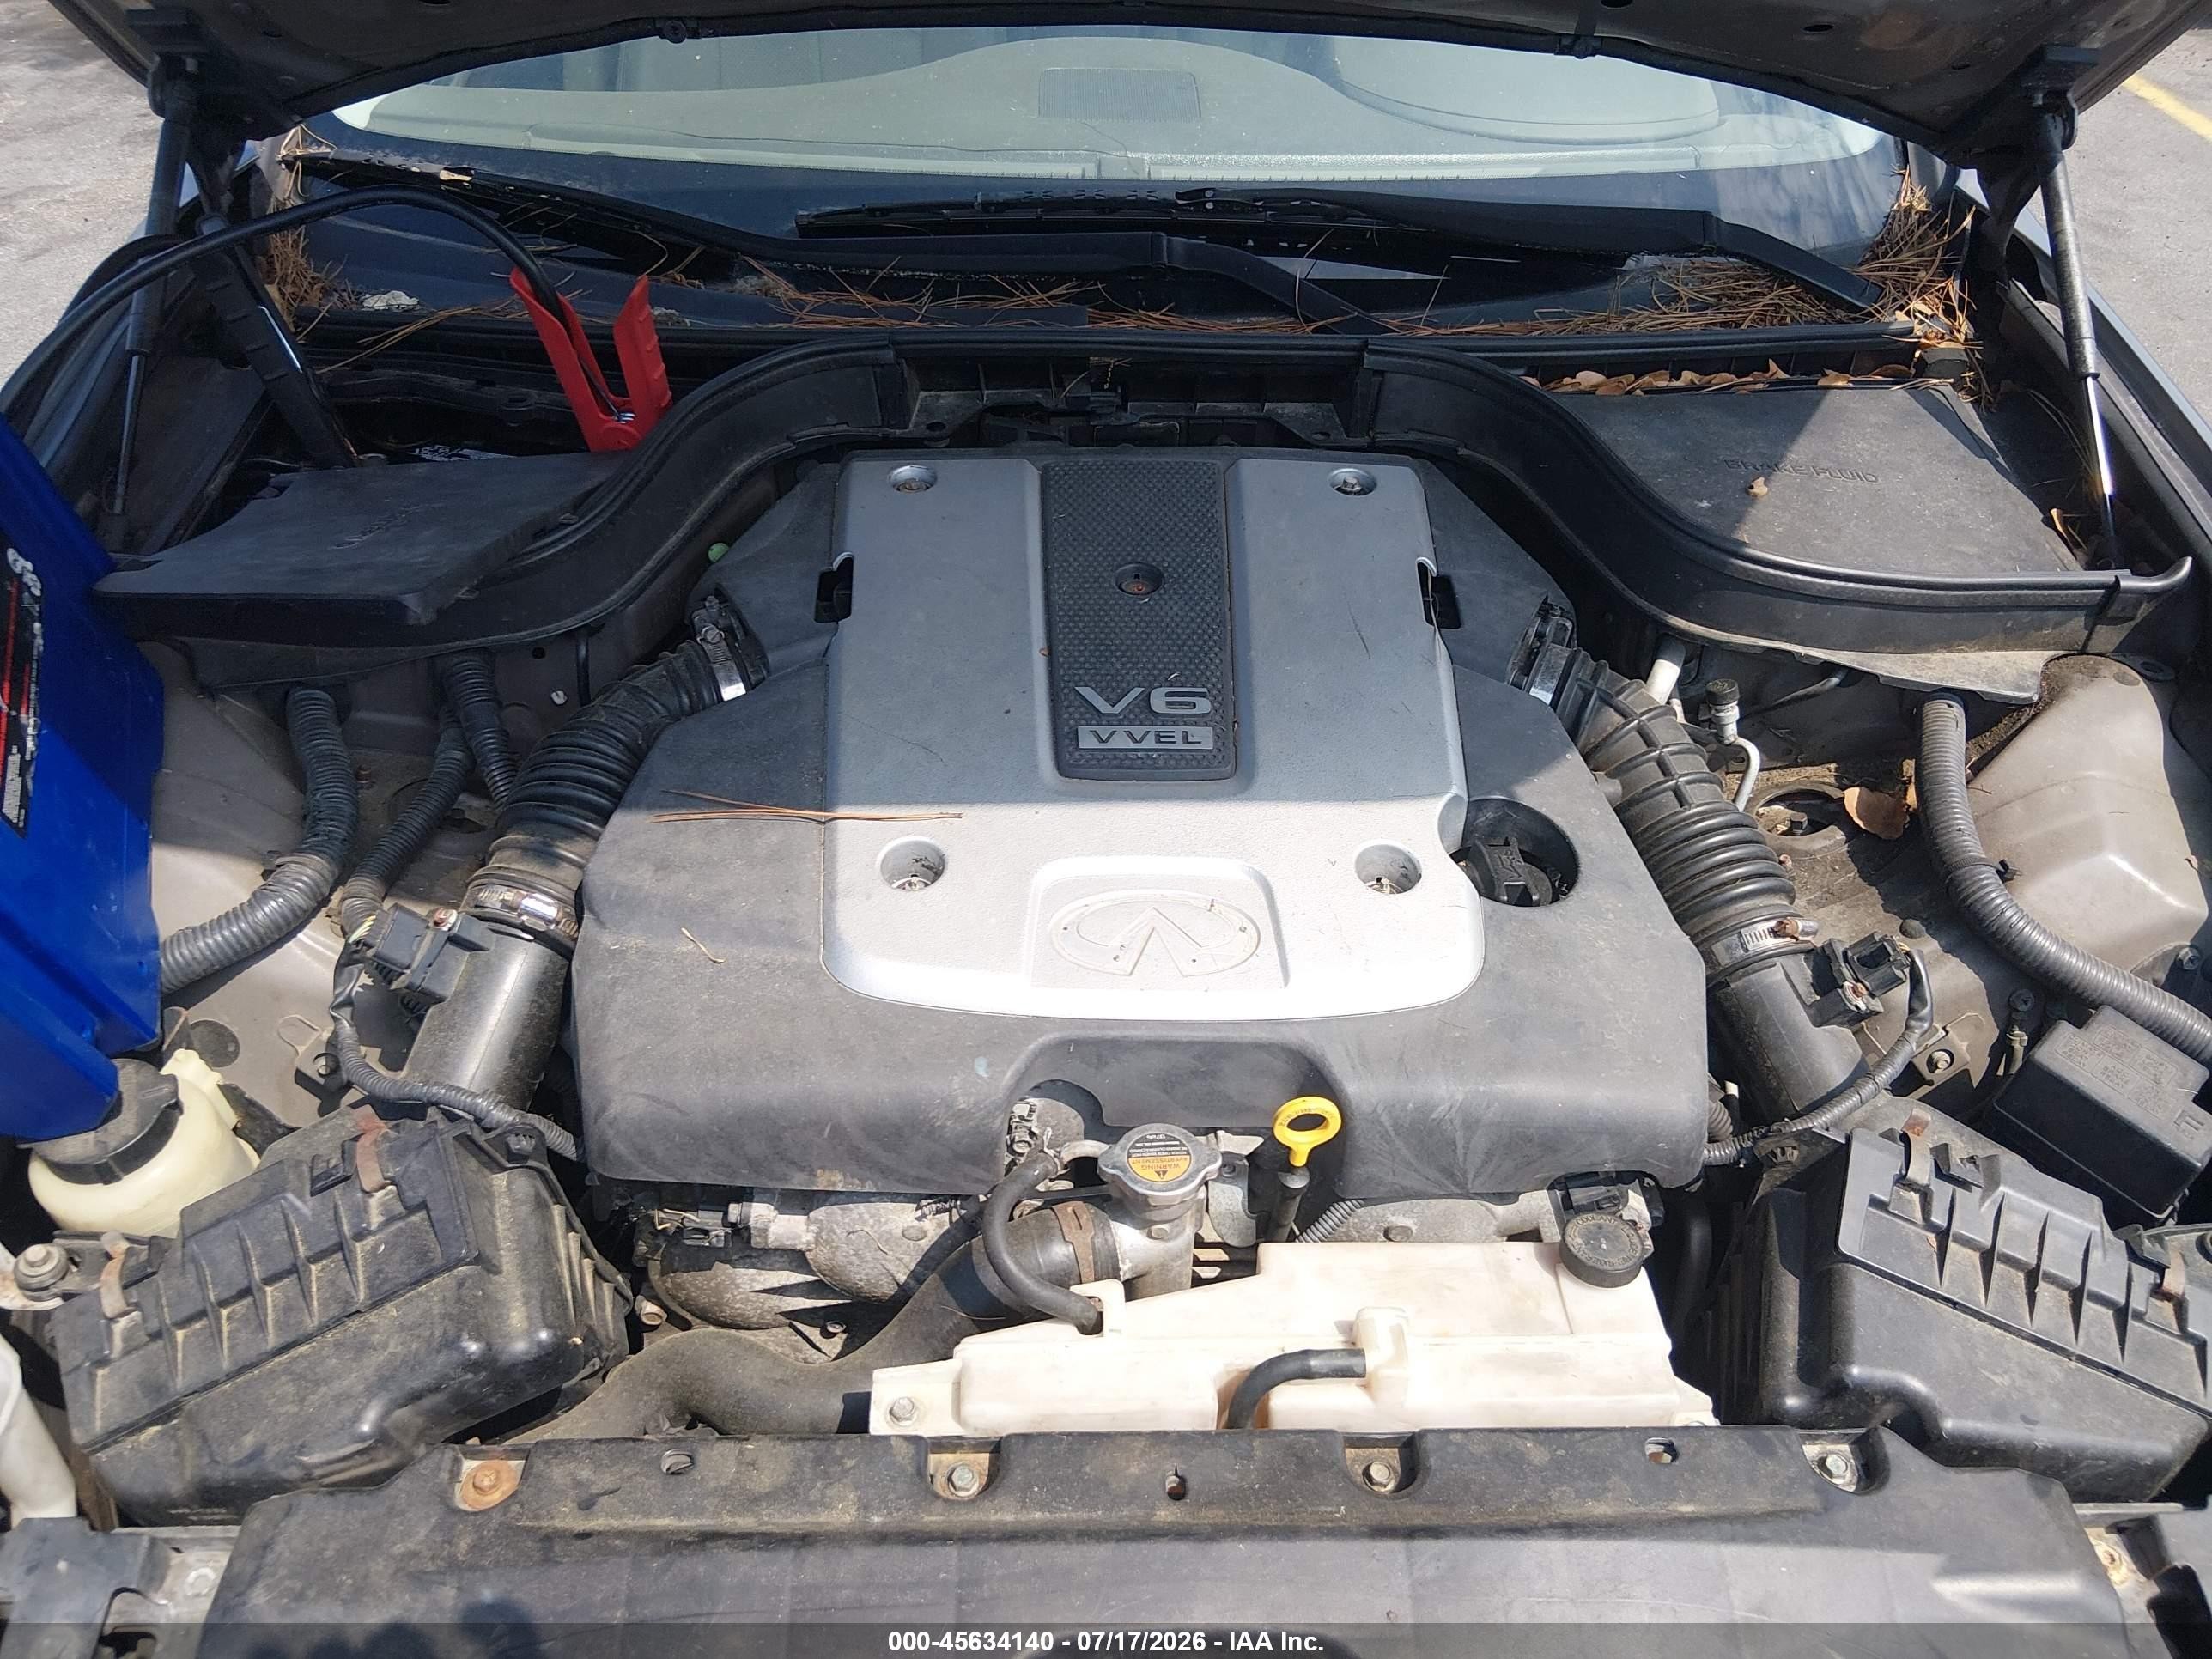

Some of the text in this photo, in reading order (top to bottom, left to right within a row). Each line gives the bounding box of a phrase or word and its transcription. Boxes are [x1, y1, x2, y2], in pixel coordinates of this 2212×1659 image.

[1723, 459, 1880, 483] BRAKE FLUID
[1074, 686, 1212, 714] V6
[1089, 729, 1203, 744] VVEL
[1576, 1215, 1617, 1224] COOLANT
